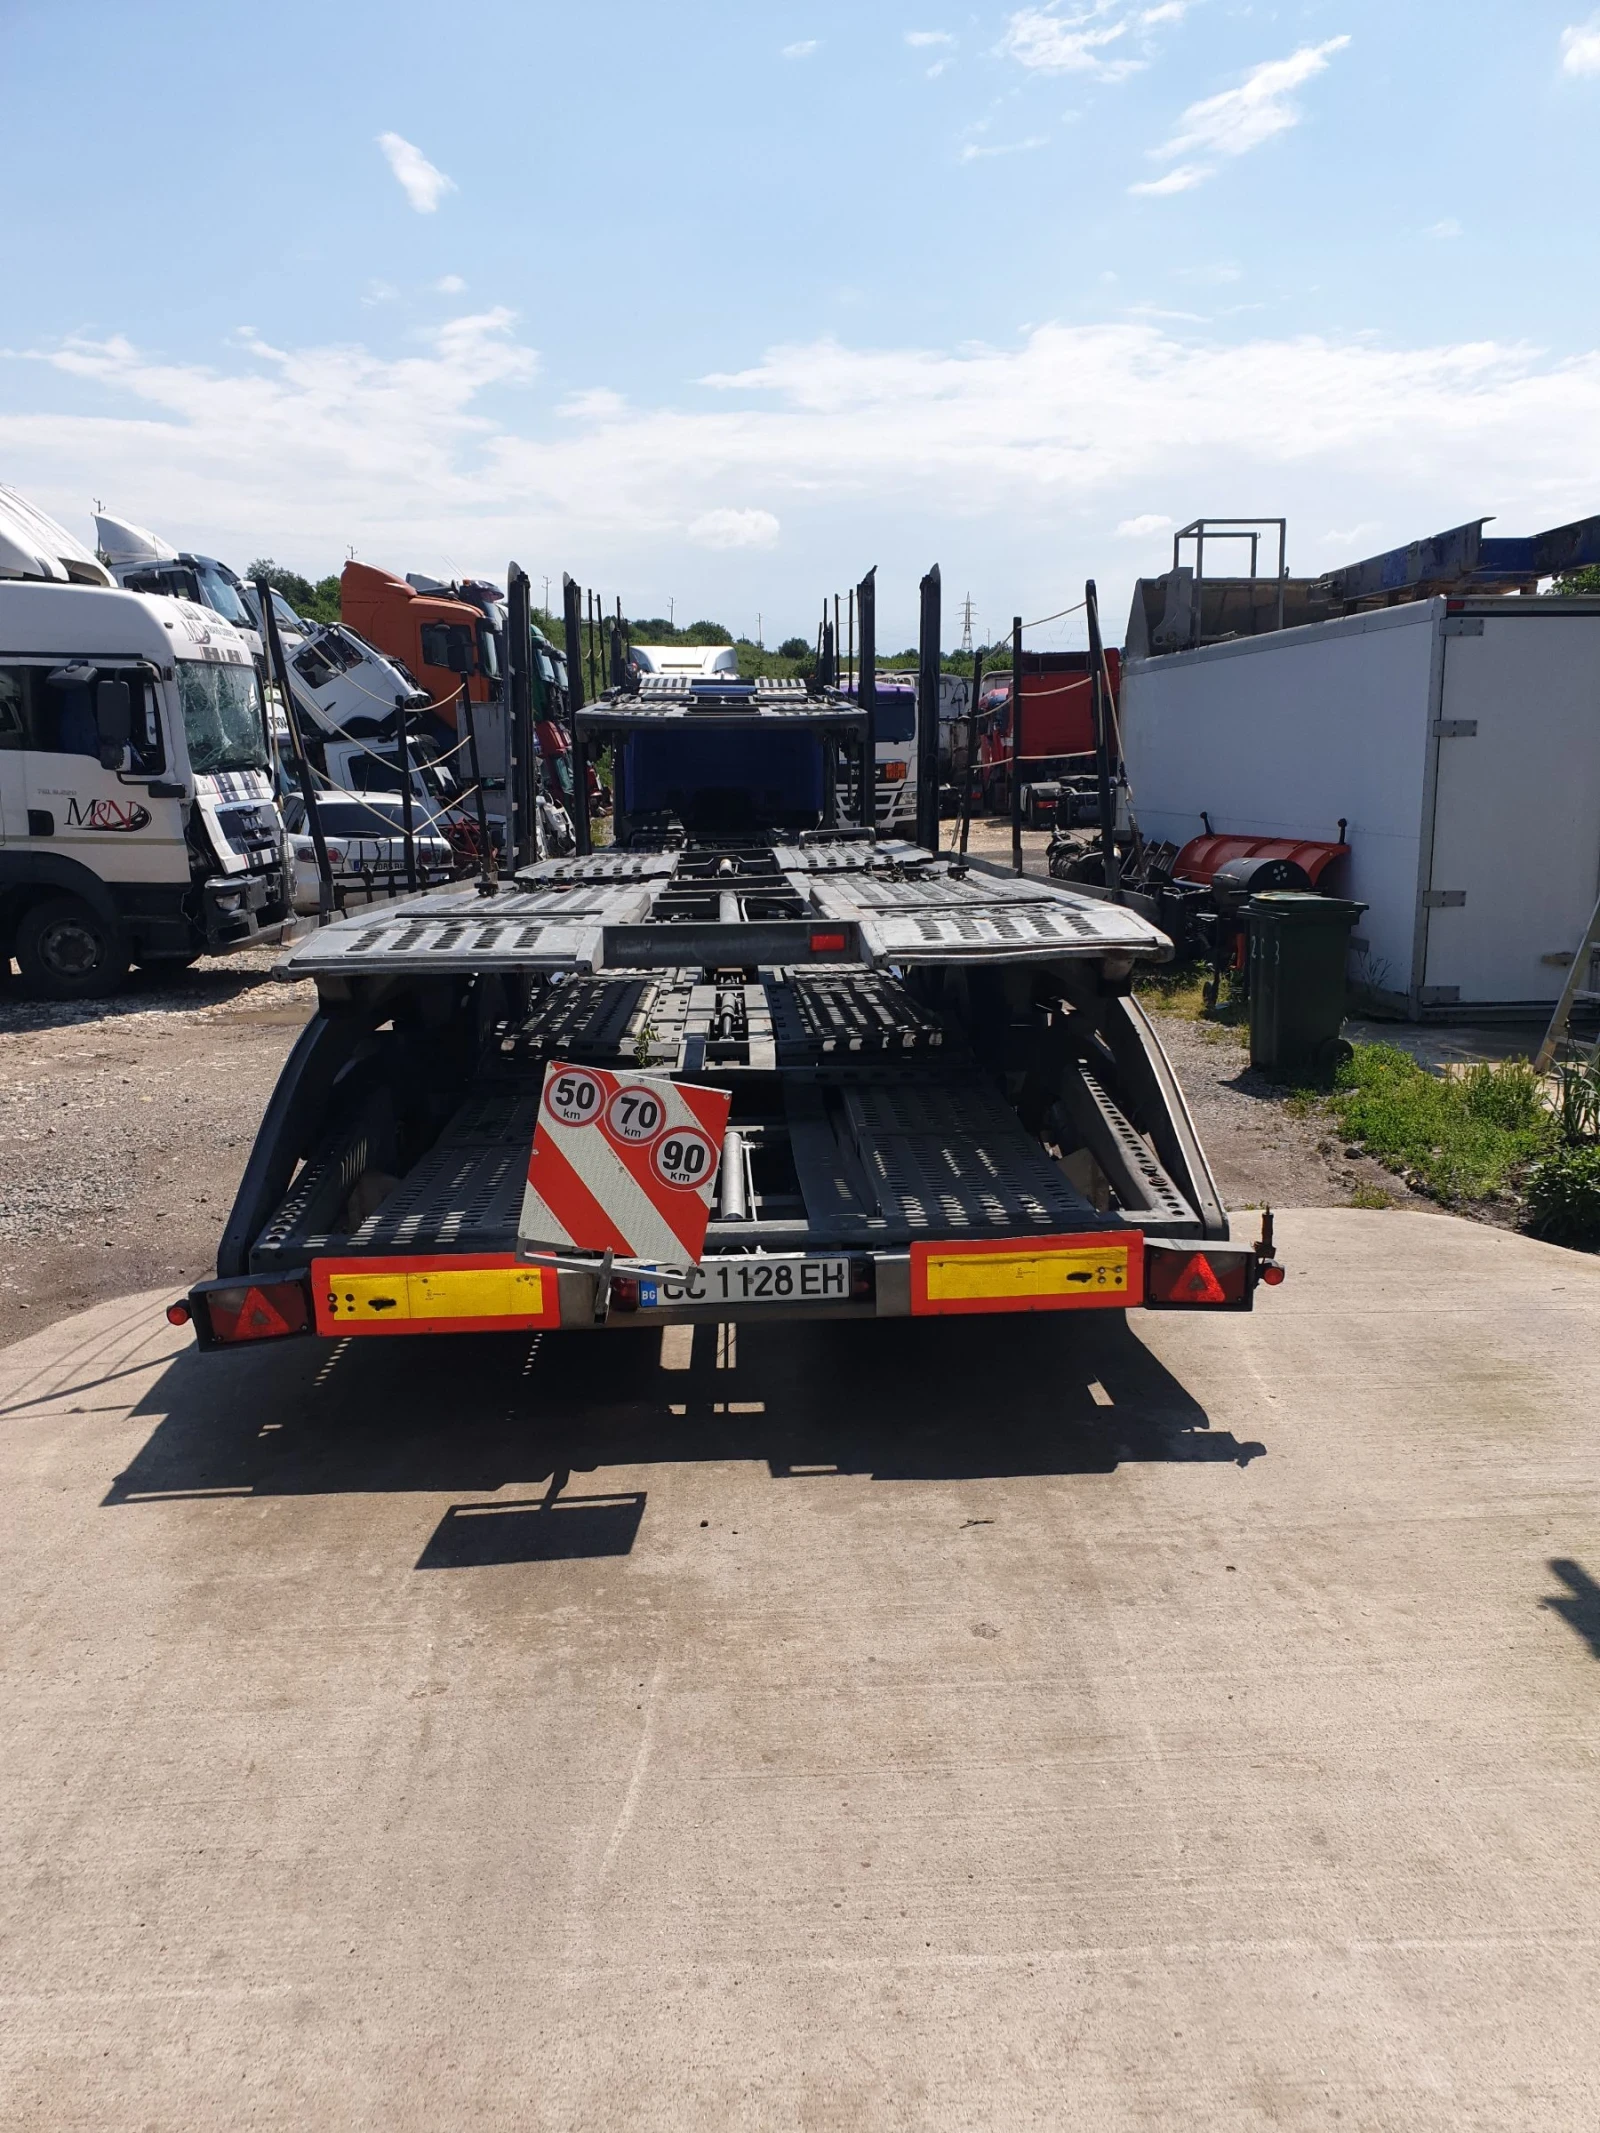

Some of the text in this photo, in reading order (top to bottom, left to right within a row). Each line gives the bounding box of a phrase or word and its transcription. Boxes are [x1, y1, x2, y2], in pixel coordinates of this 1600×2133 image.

[64, 797, 137, 831] M&N
[555, 1078, 596, 1110] 50
[563, 1108, 581, 1120] km
[620, 1096, 658, 1129] 70
[624, 1126, 641, 1138] km
[662, 1140, 705, 1174] 90
[642, 1290, 656, 1300] BG
[717, 1265, 793, 1298] 1128
[801, 1263, 844, 1295] EH
